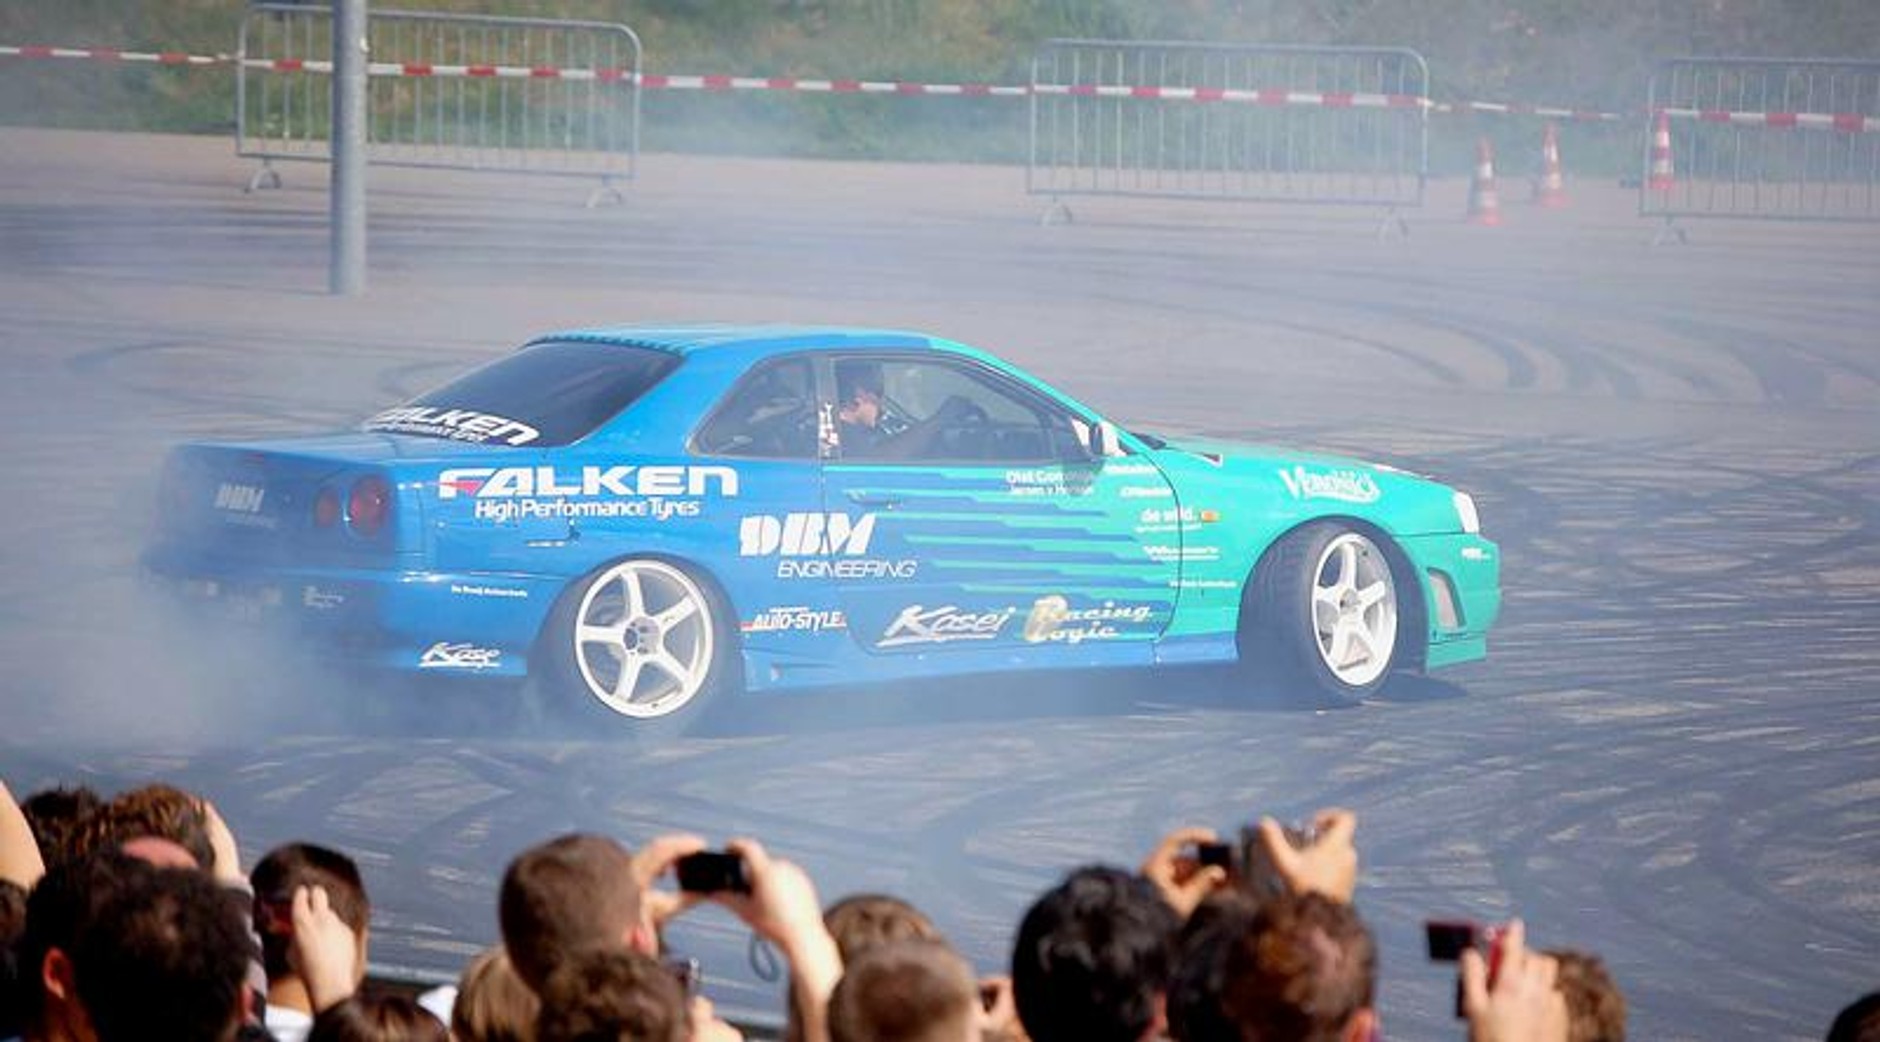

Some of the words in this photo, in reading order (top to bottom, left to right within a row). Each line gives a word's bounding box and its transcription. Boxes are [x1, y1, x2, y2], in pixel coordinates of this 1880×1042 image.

[438, 466, 739, 498] FALKEN
[475, 498, 519, 521] High
[522, 497, 647, 517] Performance
[648, 497, 700, 520] Tyres
[739, 512, 877, 556] DBM
[776, 559, 918, 578] ENGINEERING
